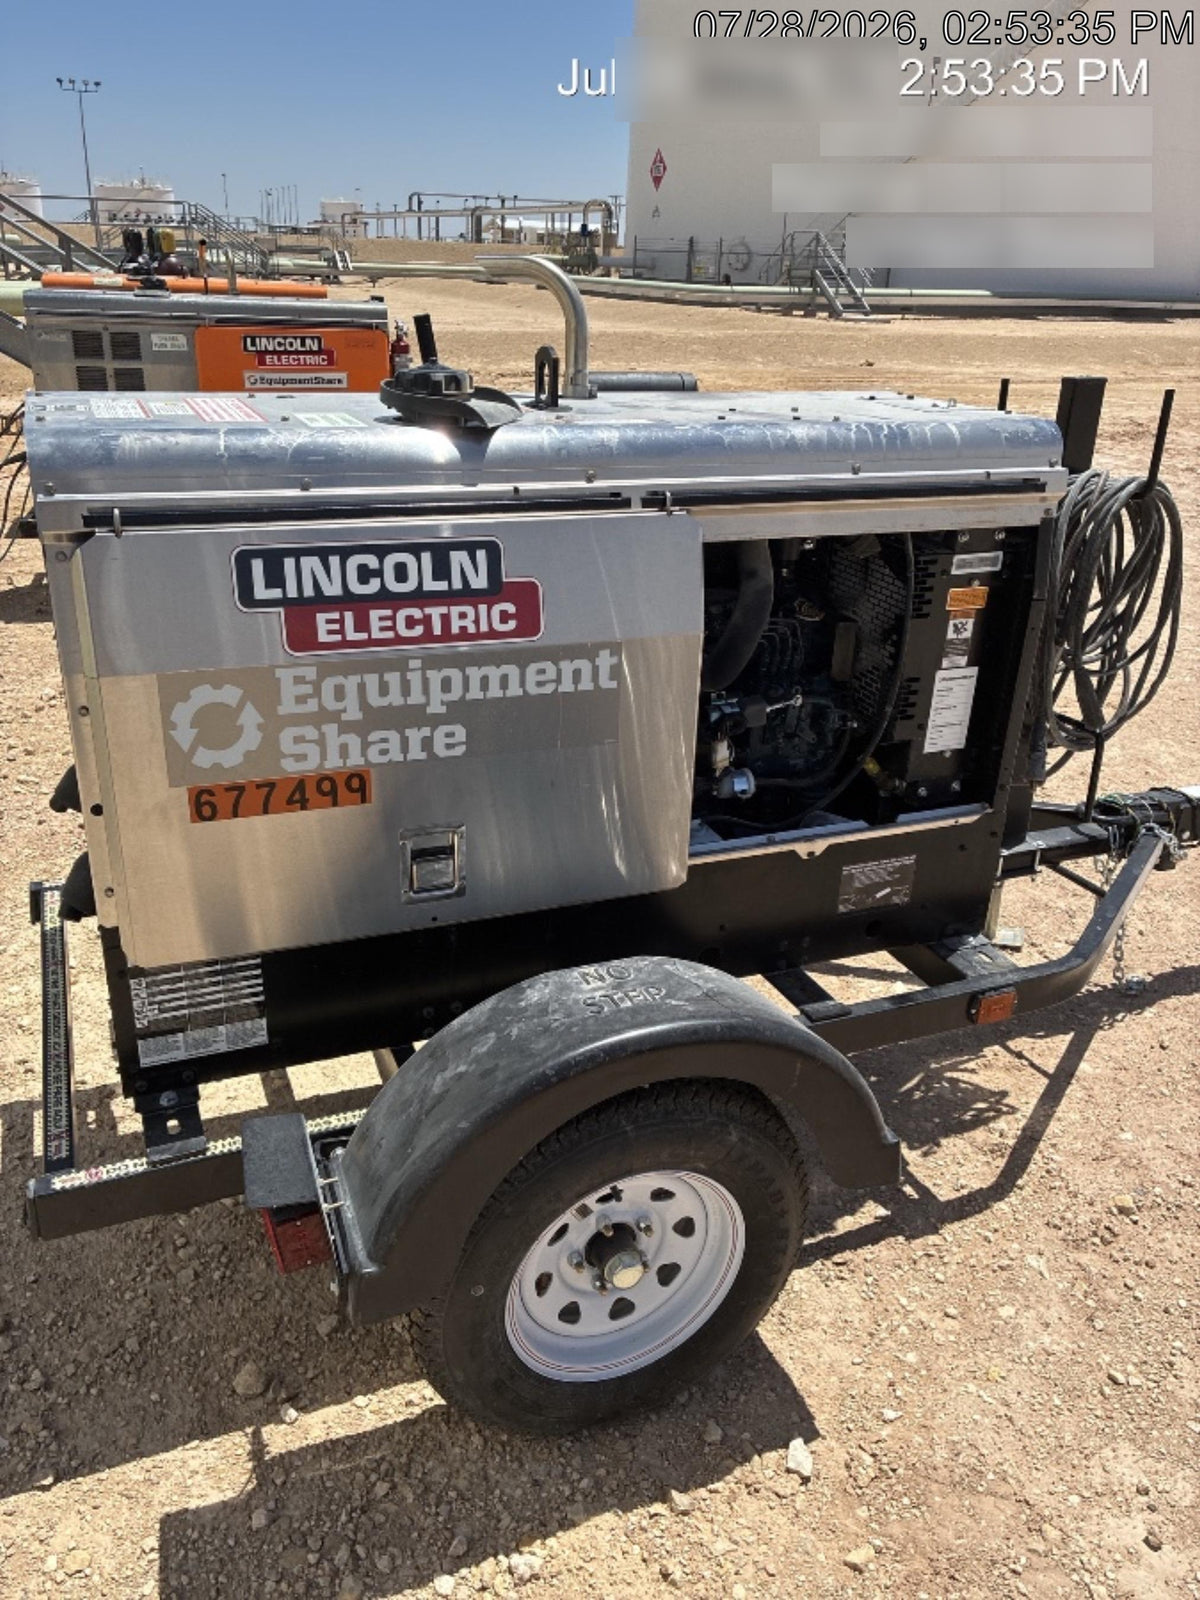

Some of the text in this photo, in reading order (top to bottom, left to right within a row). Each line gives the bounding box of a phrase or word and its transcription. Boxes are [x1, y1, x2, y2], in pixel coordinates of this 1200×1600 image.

[246, 337, 318, 351] LINCOLN
[266, 355, 328, 366] ELECTRIC
[259, 375, 344, 387] EquipmentShare
[250, 548, 489, 600] LINCOLN
[315, 602, 518, 643] ELECTRIC
[274, 648, 619, 721] Equipment
[278, 722, 467, 772] Share
[194, 772, 368, 822] 677499
[577, 965, 634, 986] NO
